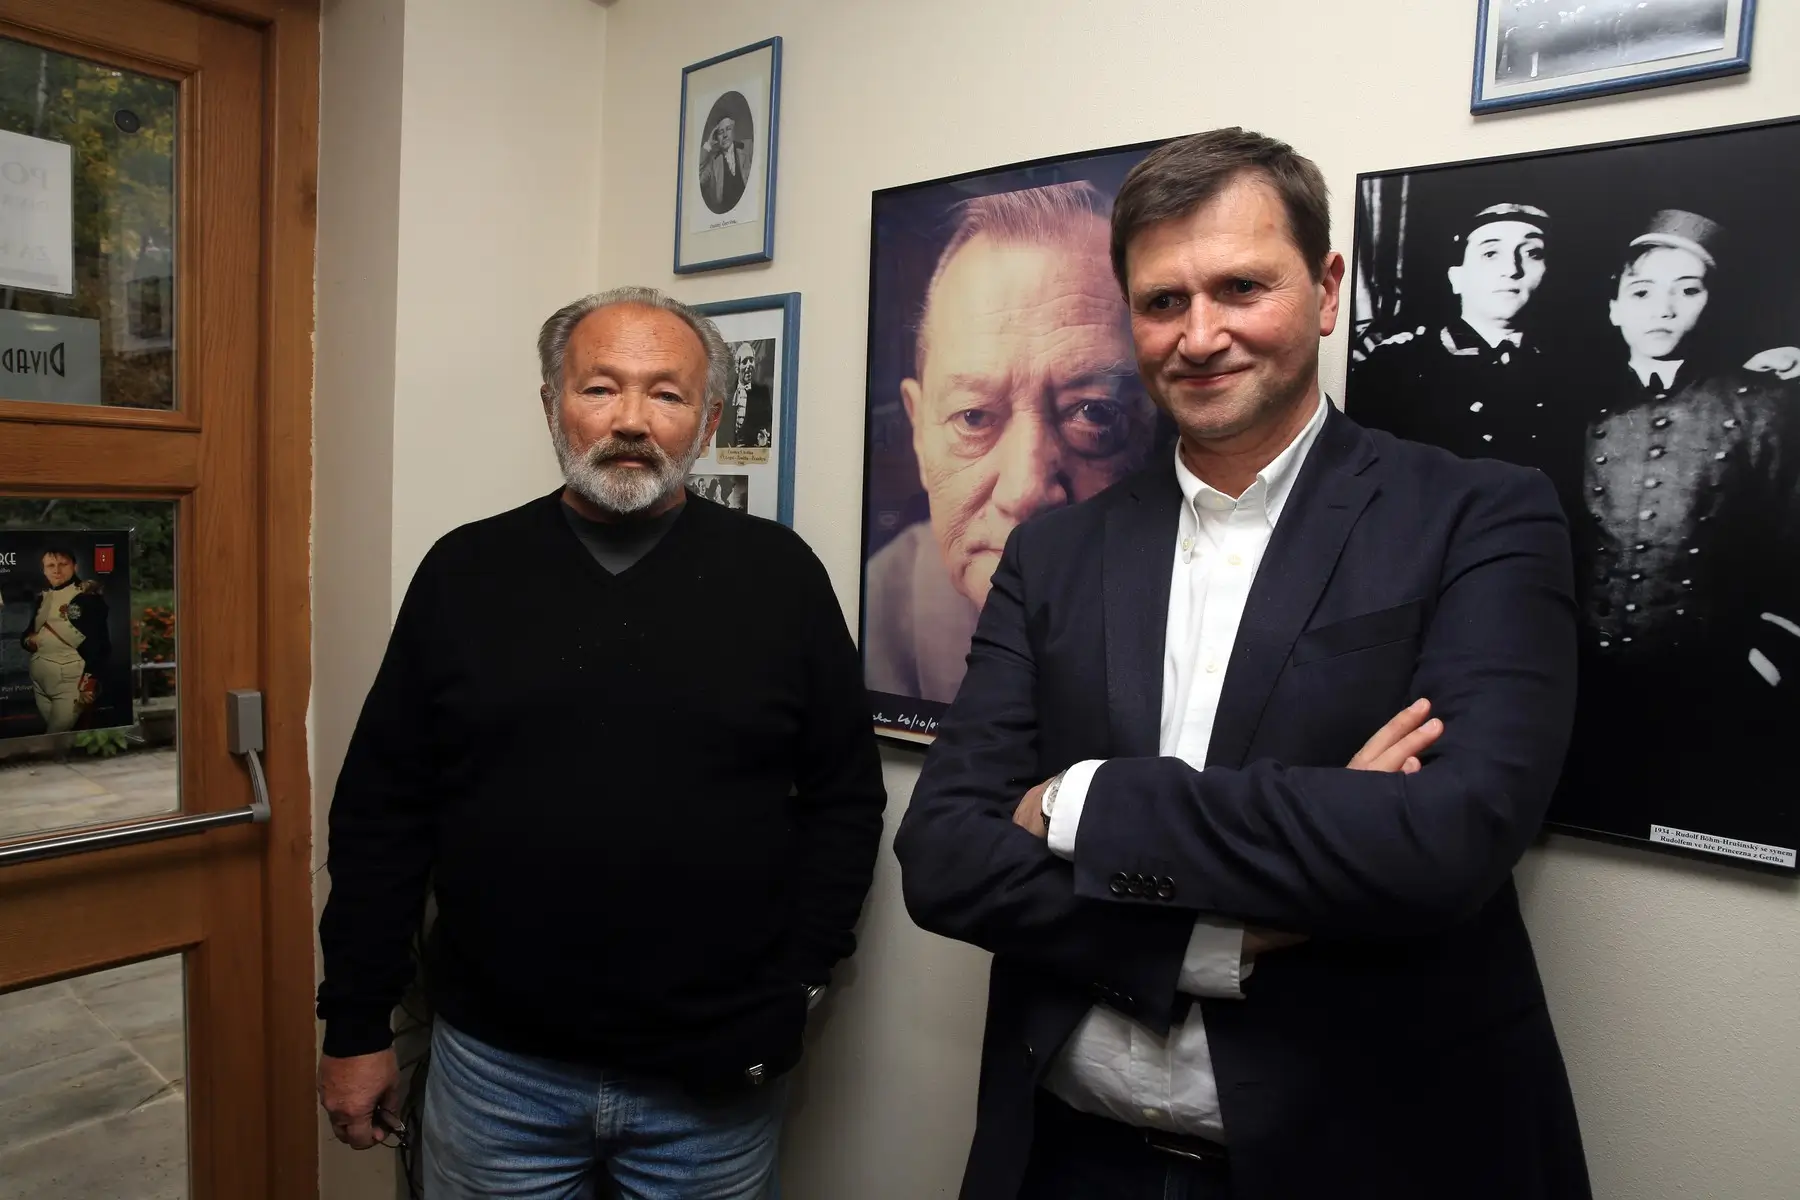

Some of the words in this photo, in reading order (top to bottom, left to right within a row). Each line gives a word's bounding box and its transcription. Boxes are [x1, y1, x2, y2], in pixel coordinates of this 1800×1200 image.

[1654, 827, 1670, 835] 1934
[1675, 830, 1699, 840] Rudolf
[1770, 848, 1793, 857] synem
[1660, 835, 1693, 846] Rudolfem
[1717, 845, 1752, 857] Princezna
